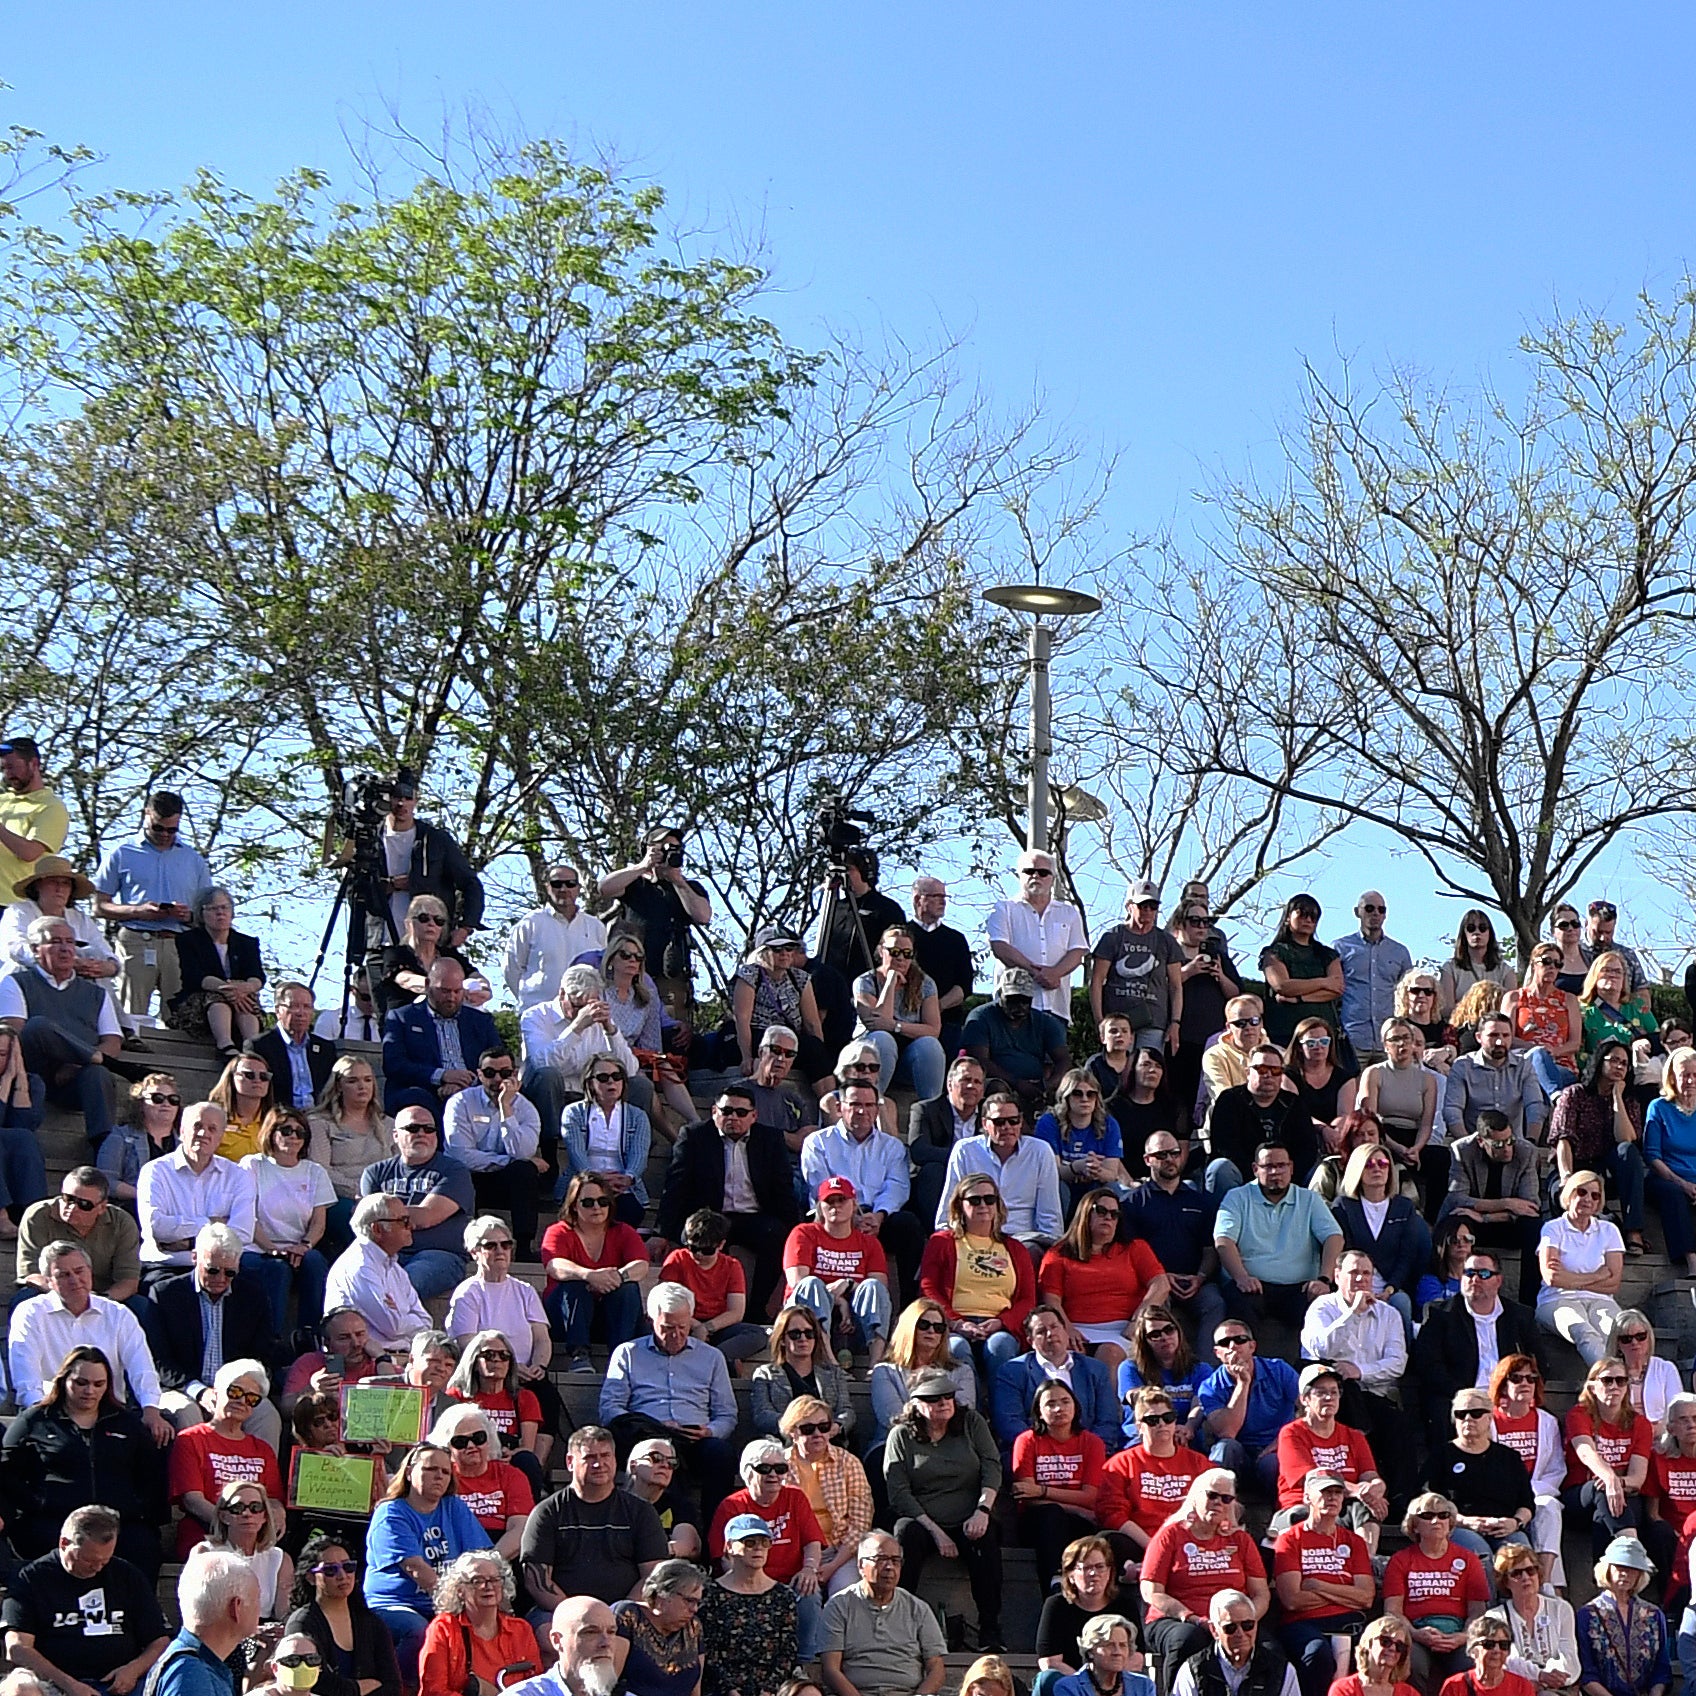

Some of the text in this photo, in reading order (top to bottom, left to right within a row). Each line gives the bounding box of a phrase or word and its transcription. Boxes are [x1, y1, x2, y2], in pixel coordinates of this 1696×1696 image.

[423, 1526, 441, 1541] NO
[425, 1541, 449, 1560] ONE
[1408, 1572, 1441, 1580] MOMS
[1408, 1580, 1456, 1589] DEMAND
[1409, 1588, 1450, 1597] ACTION
